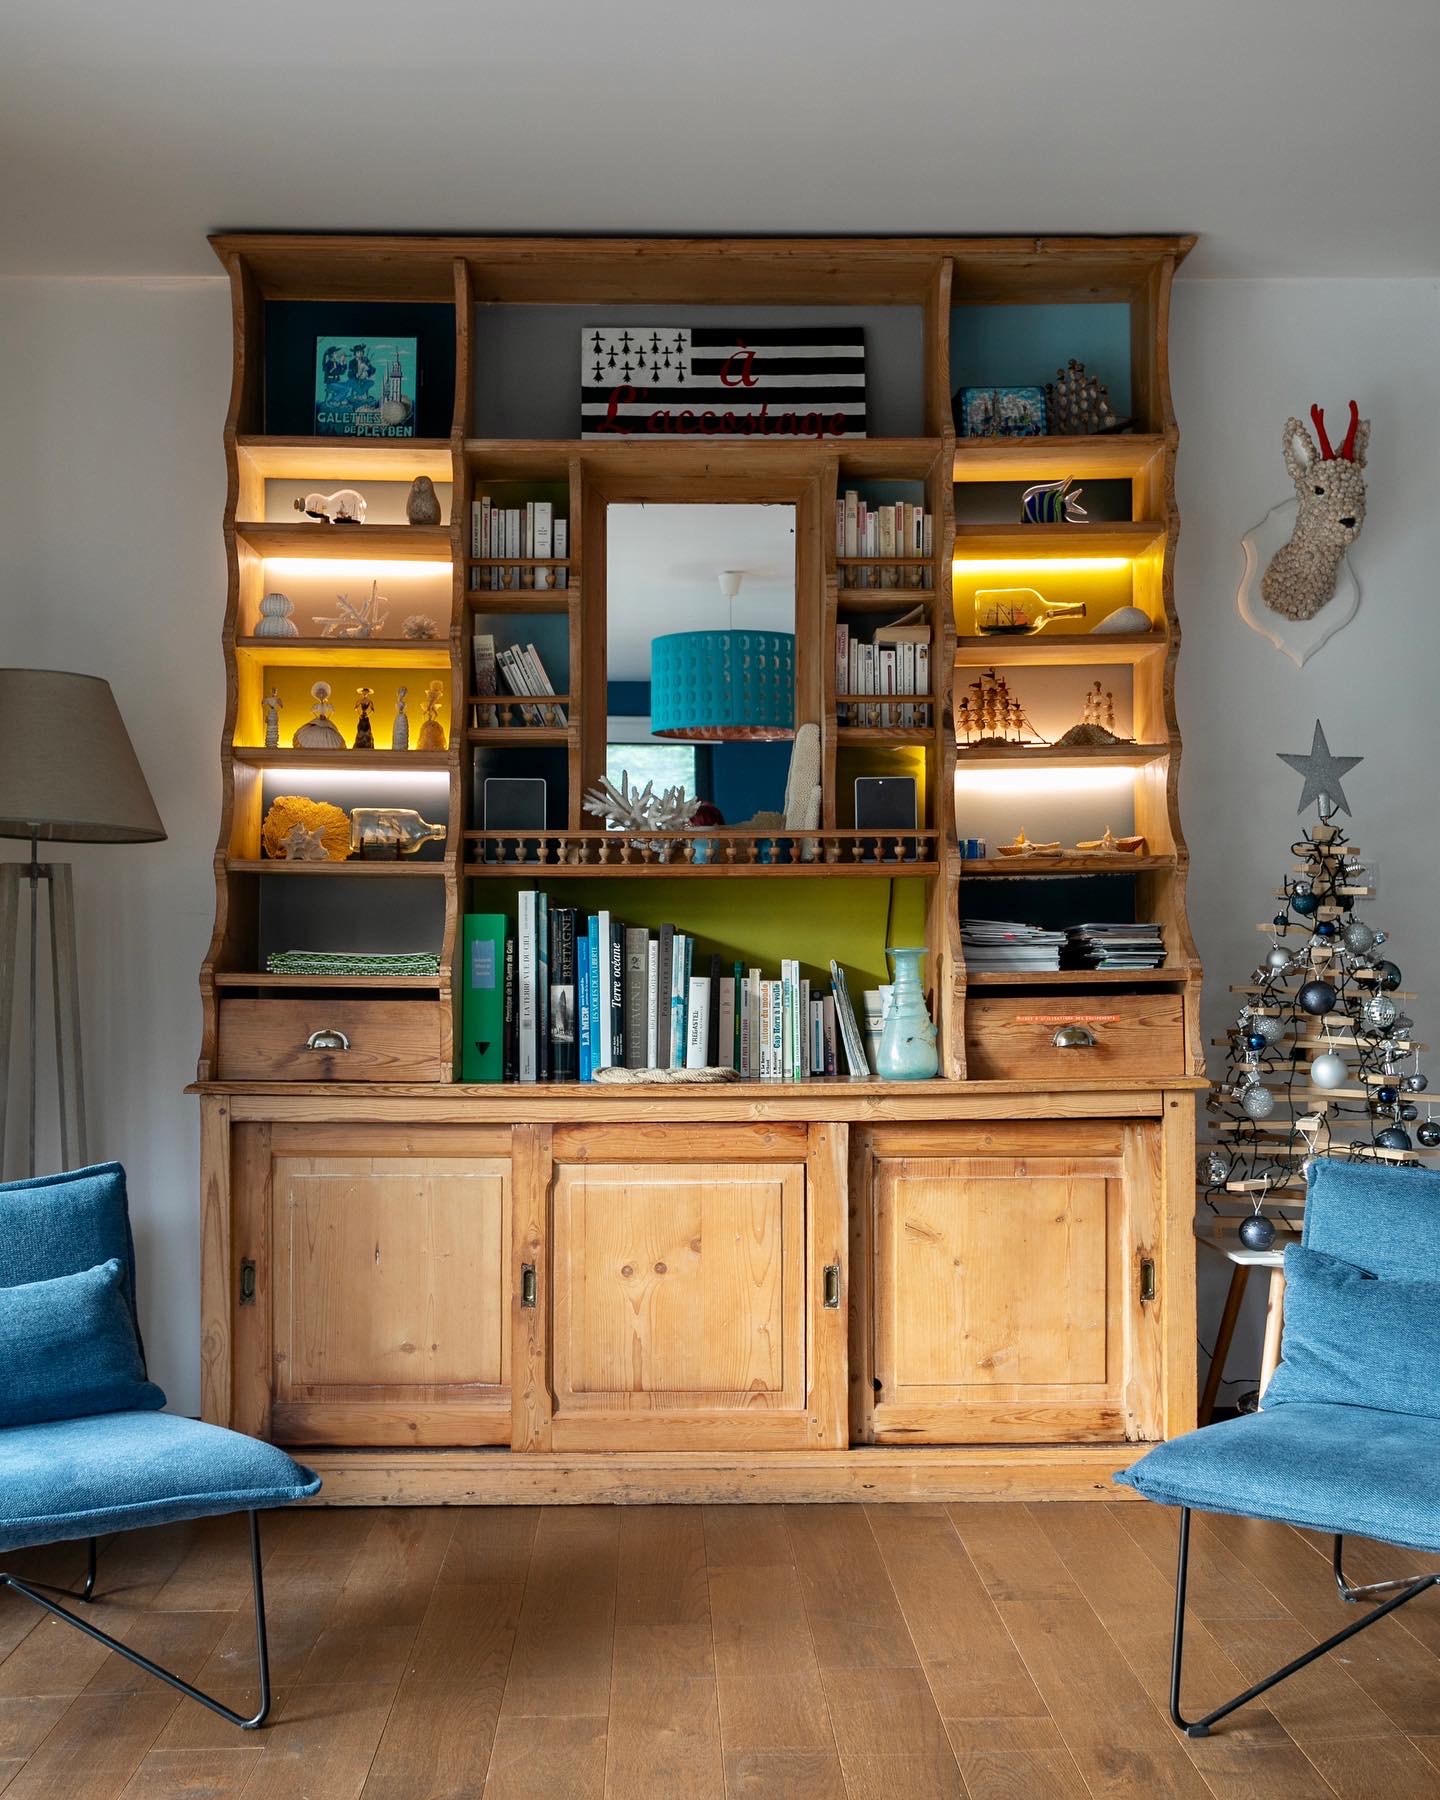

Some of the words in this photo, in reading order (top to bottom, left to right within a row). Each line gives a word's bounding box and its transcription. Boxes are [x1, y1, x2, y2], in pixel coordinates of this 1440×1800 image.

[317, 412, 382, 424] GALETTES
[344, 425, 357, 434] DE
[357, 426, 412, 437] PLEYBEN
[562, 915, 572, 977] BRETAGNE
[612, 943, 621, 978] océane
[612, 981, 622, 1008] Terre
[761, 984, 769, 1008] monde
[772, 983, 780, 1001] voile
[761, 1009, 769, 1018] du
[772, 1001, 780, 1009] la
[581, 1007, 590, 1030] MER
[631, 981, 641, 1058] BRETAGNE
[773, 1016, 781, 1034] Horn
[582, 1032, 590, 1046] LA
[761, 1019, 769, 1045] Autour
[773, 1035, 782, 1049] Cap
